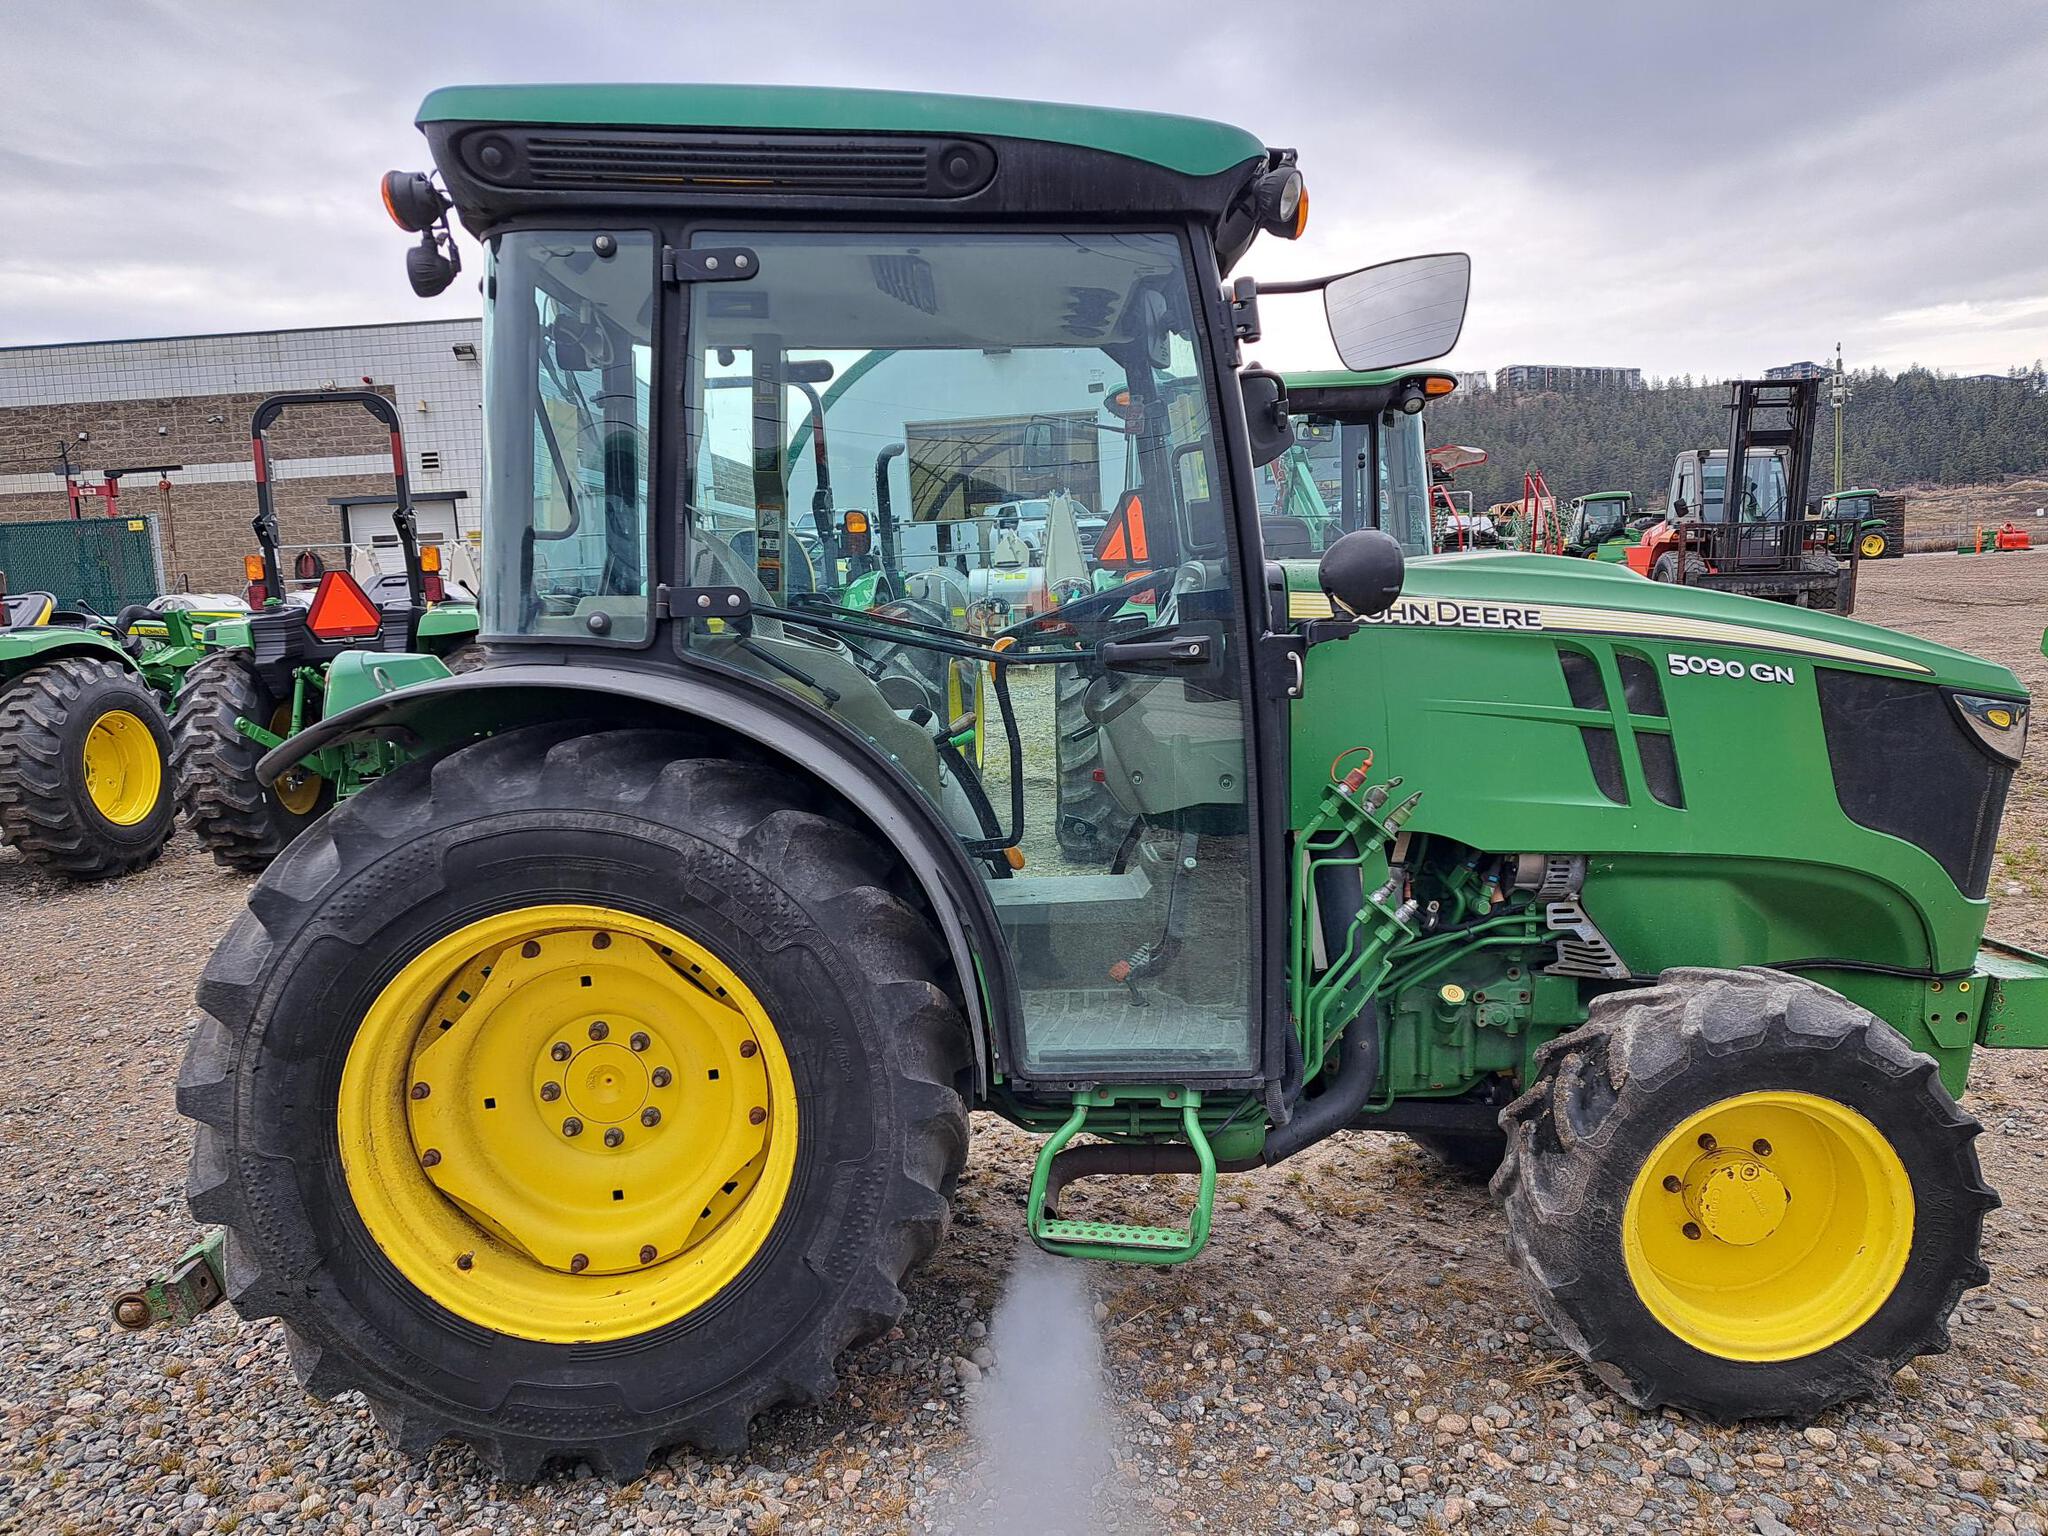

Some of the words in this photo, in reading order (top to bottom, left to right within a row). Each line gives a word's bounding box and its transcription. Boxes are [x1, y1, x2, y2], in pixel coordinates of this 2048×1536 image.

[1436, 601, 1543, 629] DEERE
[1667, 653, 1745, 678] 5090
[1749, 663, 1795, 684] GN
